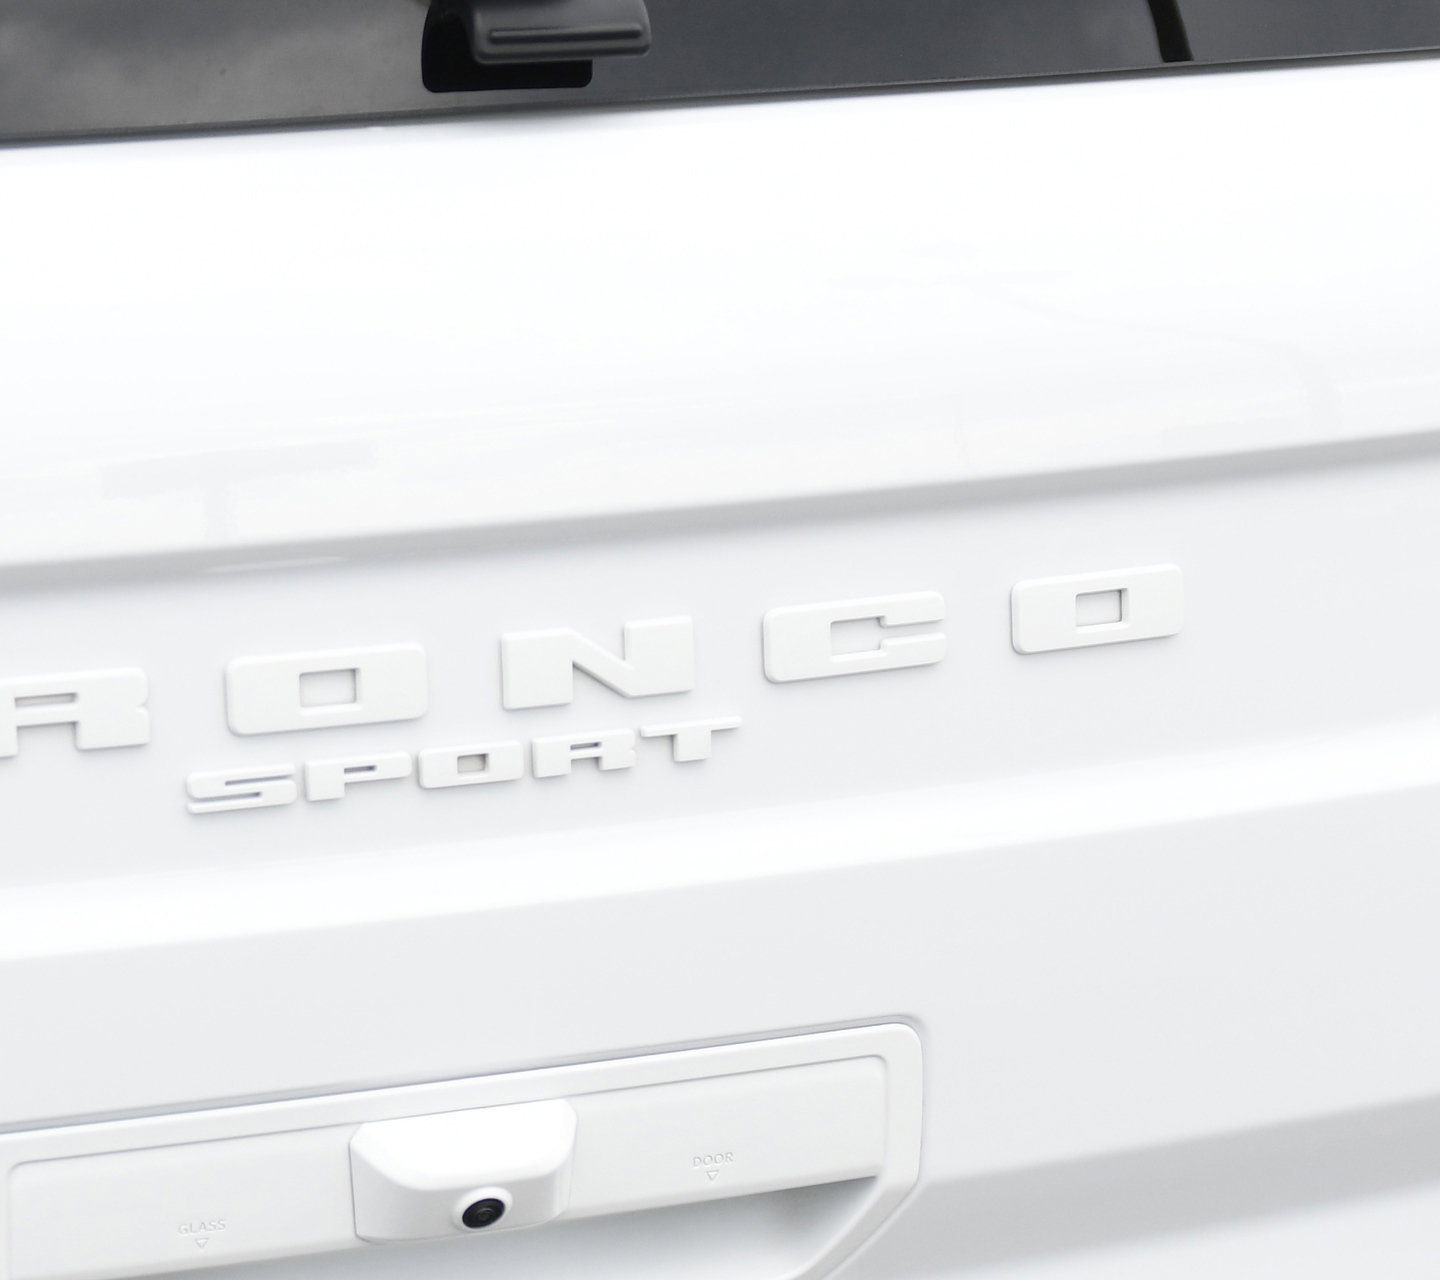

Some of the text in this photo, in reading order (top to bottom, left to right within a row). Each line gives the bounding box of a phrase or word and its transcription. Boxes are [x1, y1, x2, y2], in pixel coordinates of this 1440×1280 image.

[185, 715, 742, 815] SPORT
[691, 1151, 734, 1167] DOOR
[177, 1218, 226, 1235] GLASS
